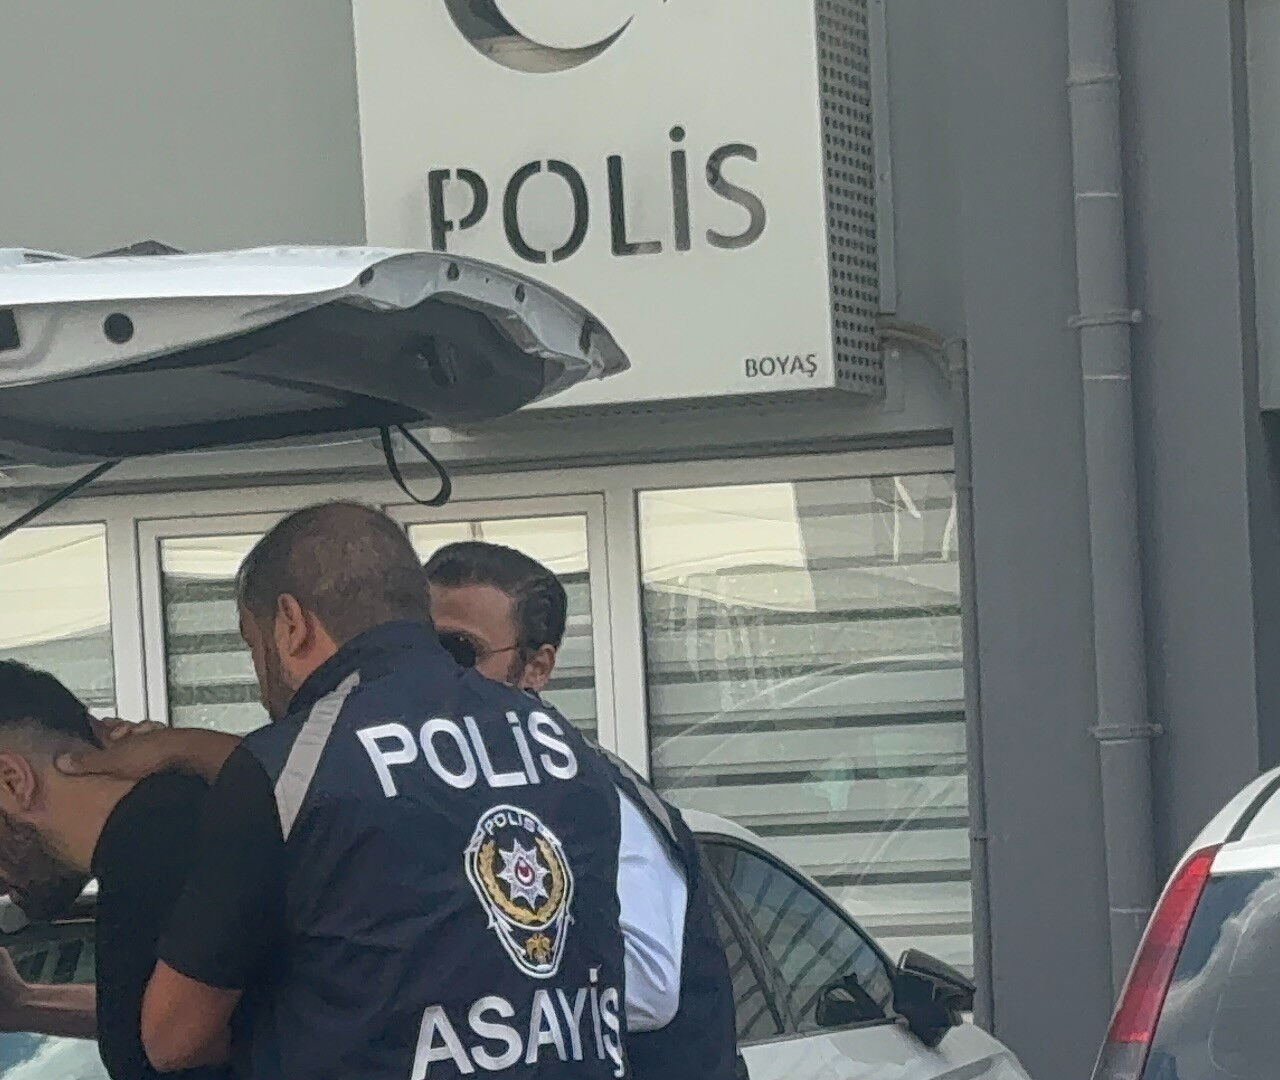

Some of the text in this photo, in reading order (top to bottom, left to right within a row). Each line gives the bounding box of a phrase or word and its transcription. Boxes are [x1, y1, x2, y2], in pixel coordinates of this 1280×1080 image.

[426, 125, 767, 265] POLİS
[744, 355, 819, 379] BOYAŞ
[357, 711, 578, 797] POLİS
